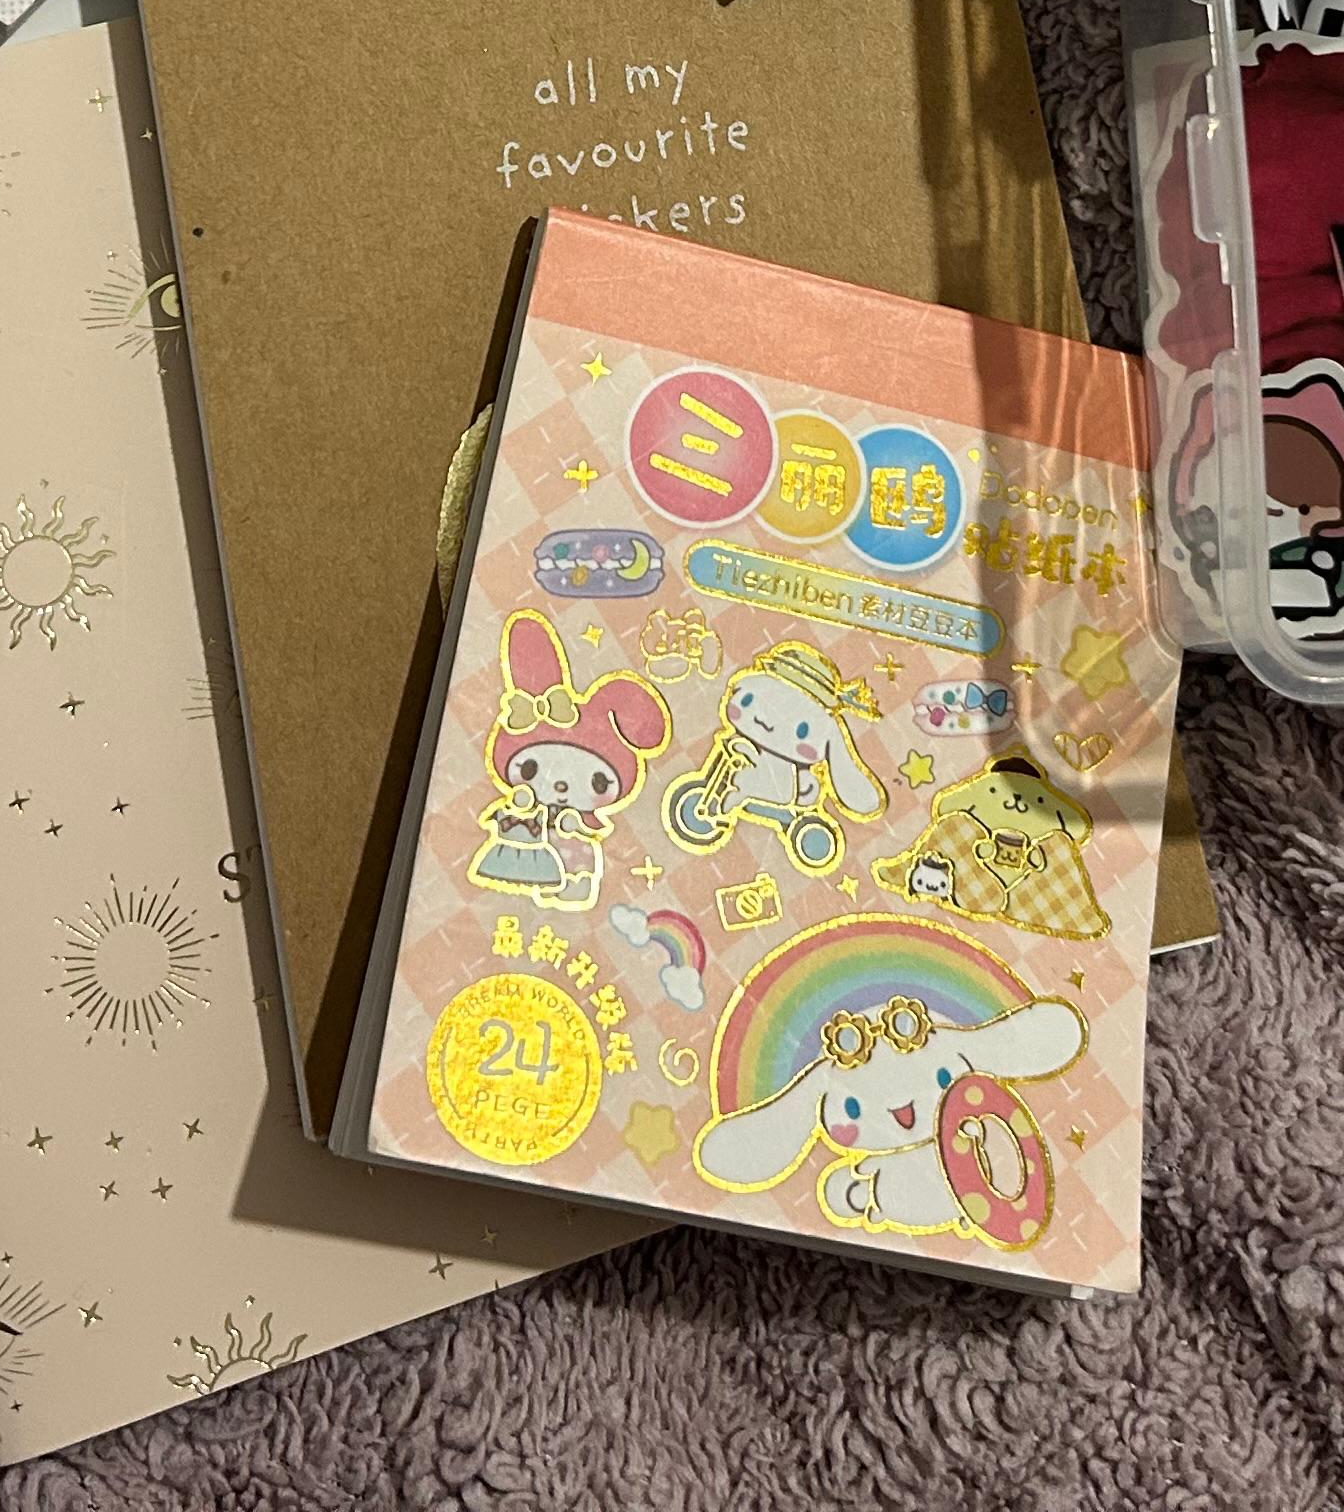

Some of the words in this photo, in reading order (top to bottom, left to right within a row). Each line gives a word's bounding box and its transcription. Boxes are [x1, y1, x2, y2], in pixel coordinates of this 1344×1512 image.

[533, 56, 598, 106] all
[624, 59, 689, 106] my
[496, 111, 750, 188] favourite
[580, 194, 746, 233] kers
[649, 391, 948, 538] 三丽鸥
[712, 552, 852, 615] Tiezhiben
[477, 1017, 560, 1086] 24
[473, 1088, 553, 1120] PEGE
